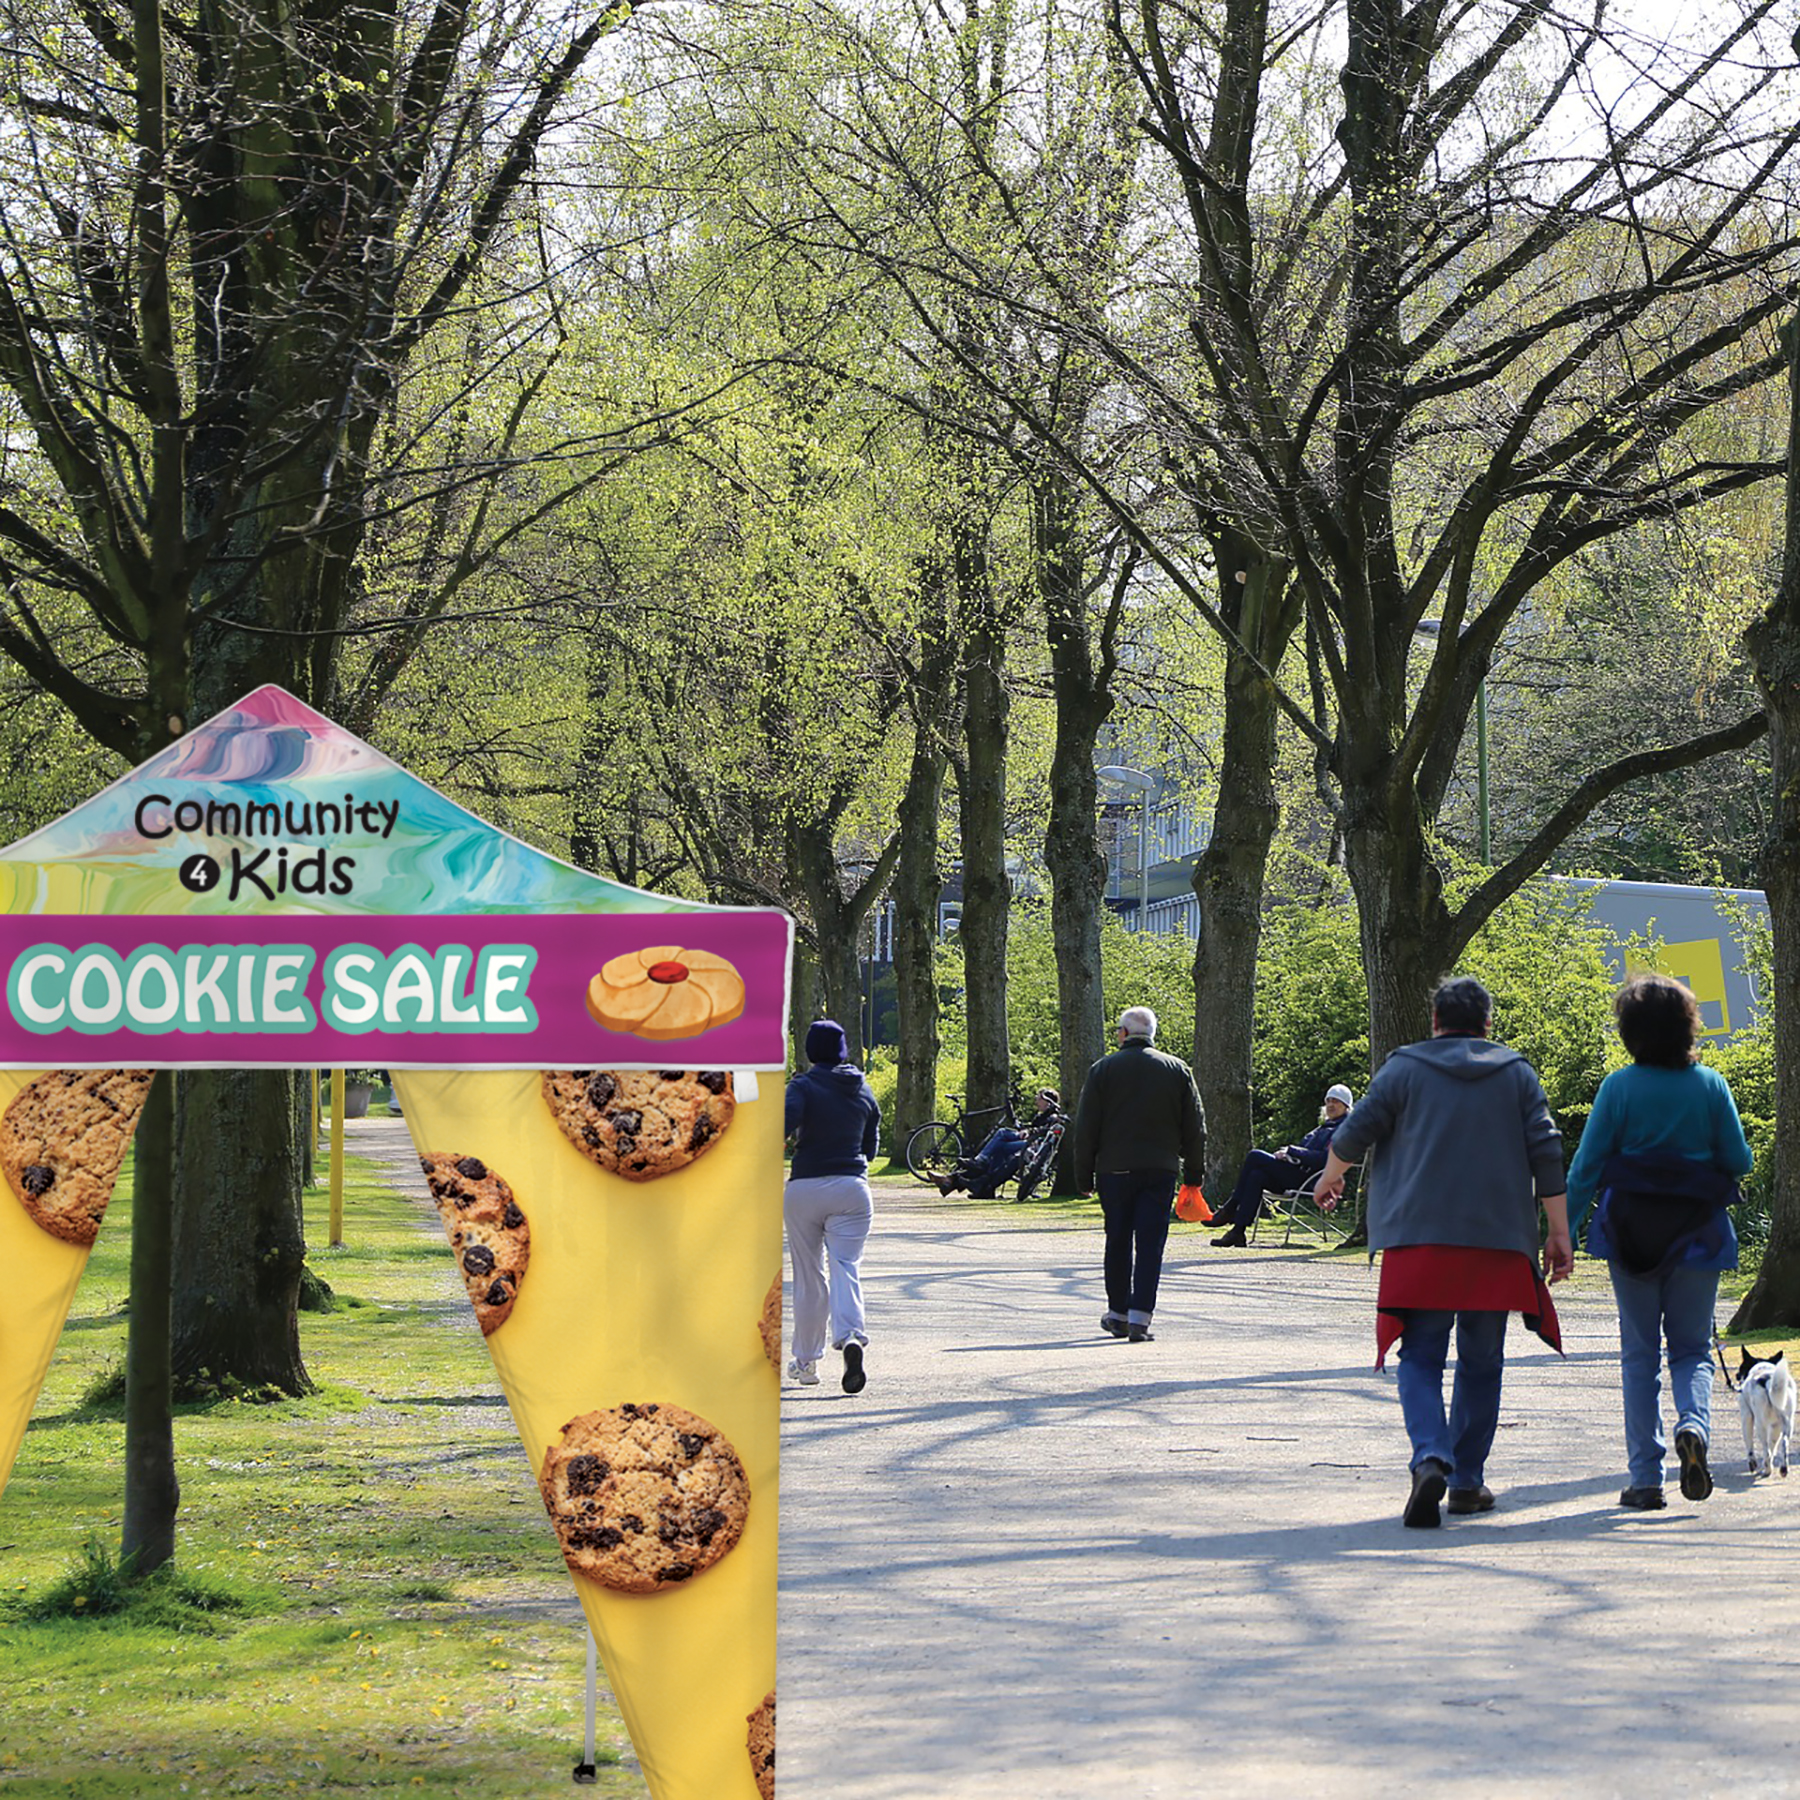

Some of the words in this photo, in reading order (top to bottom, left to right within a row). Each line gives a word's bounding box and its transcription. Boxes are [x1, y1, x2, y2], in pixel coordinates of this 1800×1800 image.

[134, 793, 400, 840] Community
[188, 856, 209, 888] 4
[228, 846, 357, 902] Kids
[14, 951, 310, 1026] COOKIE
[328, 951, 532, 1026] SALE
